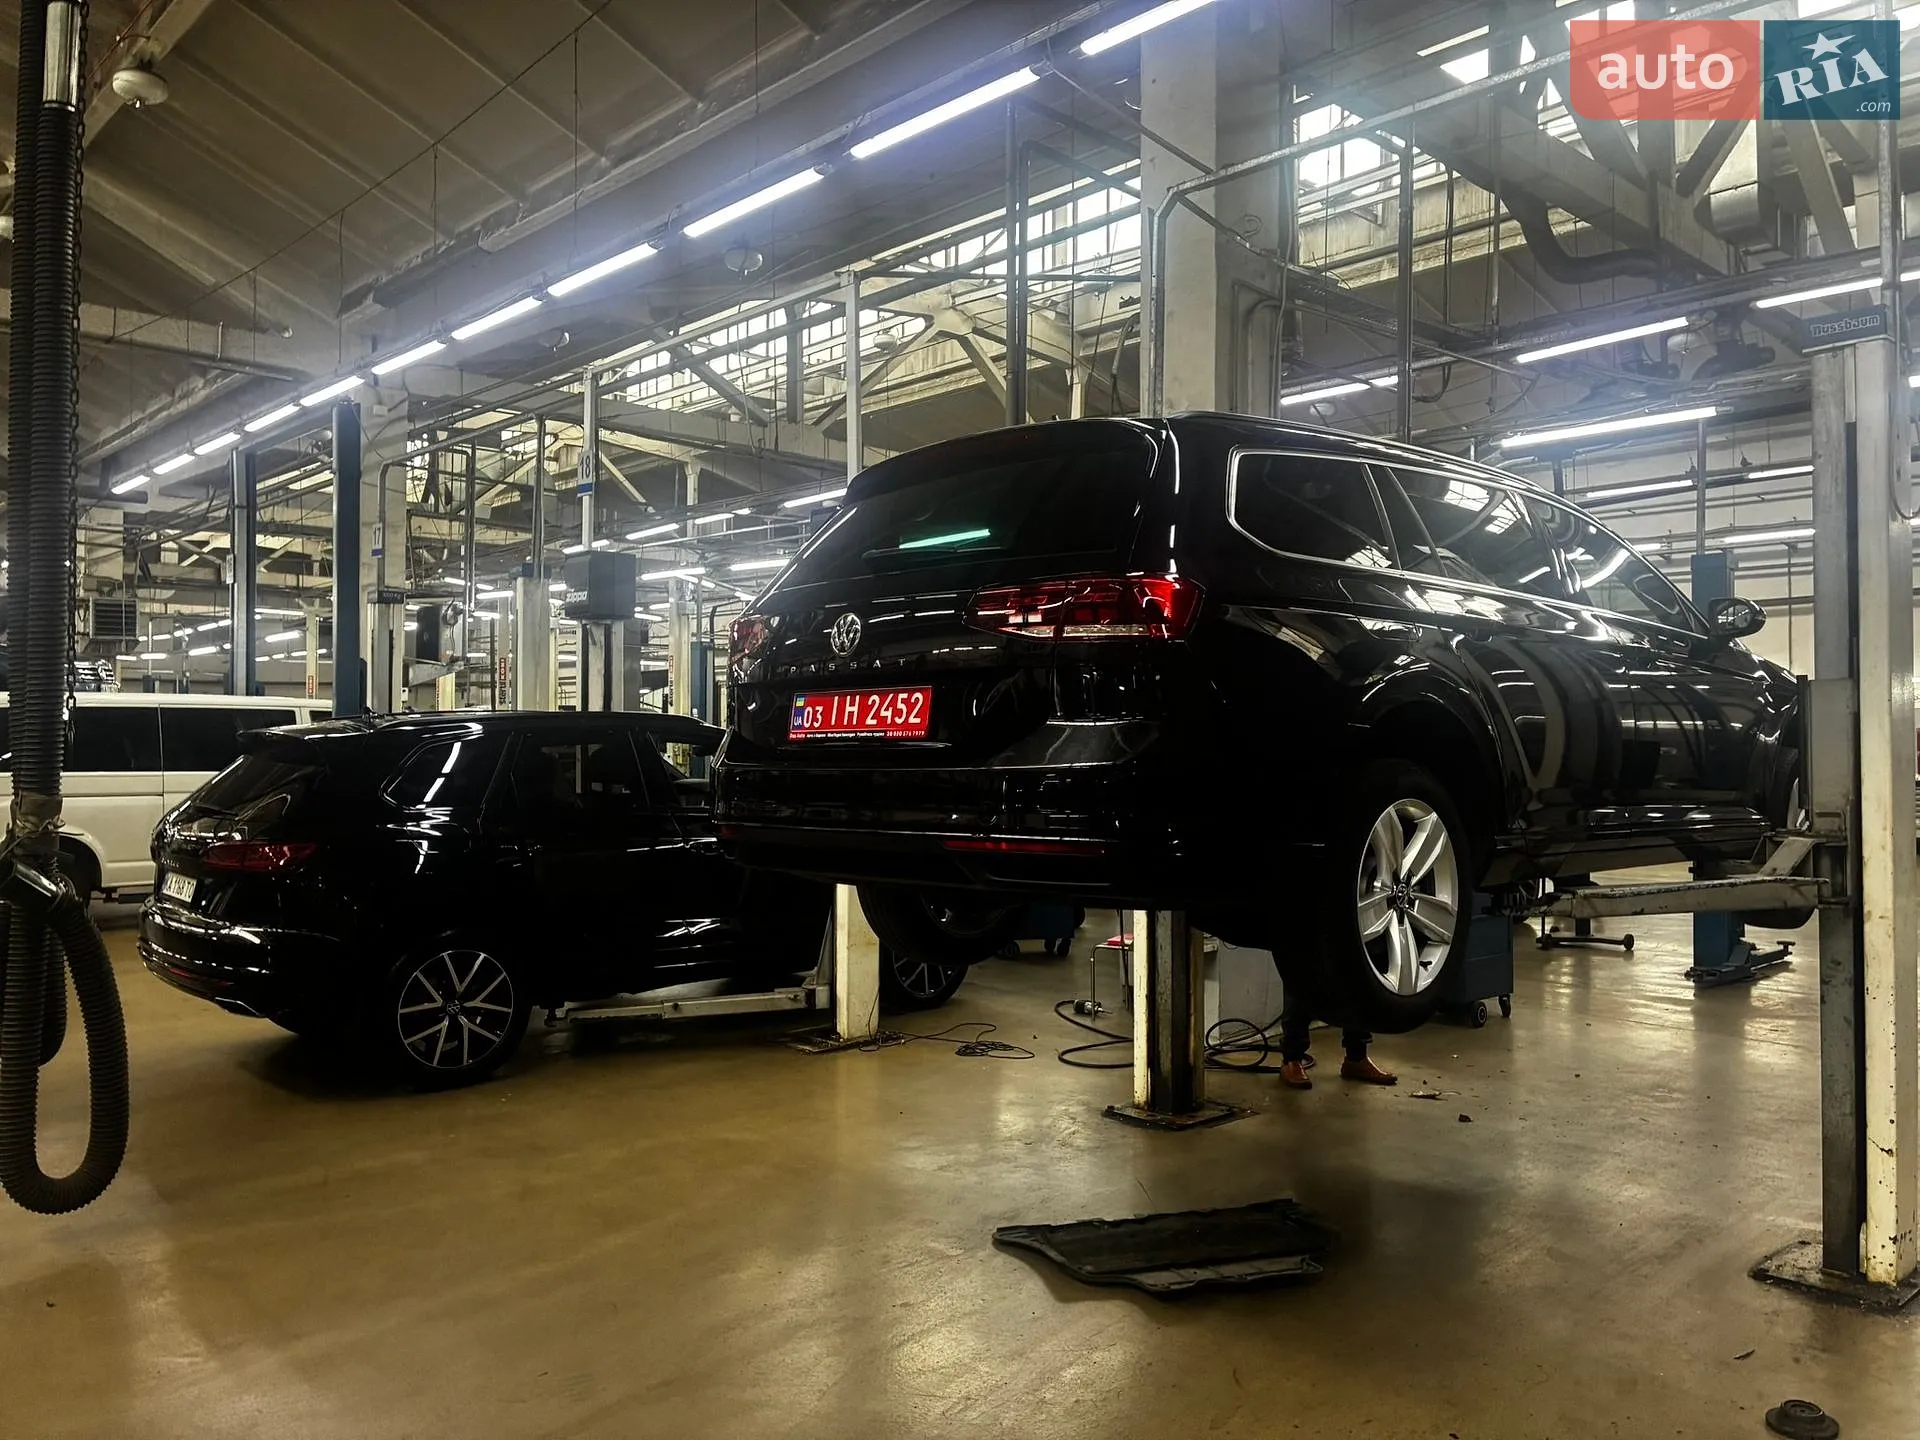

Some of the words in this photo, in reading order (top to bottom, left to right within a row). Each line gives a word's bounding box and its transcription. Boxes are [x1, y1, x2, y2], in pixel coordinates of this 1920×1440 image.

[580, 455, 591, 480] 18
[373, 527, 381, 545] 17
[789, 658, 906, 674] PASSAT
[793, 716, 803, 727] UA
[803, 705, 824, 728] 03
[831, 694, 860, 726] IH
[865, 692, 924, 725] 2452
